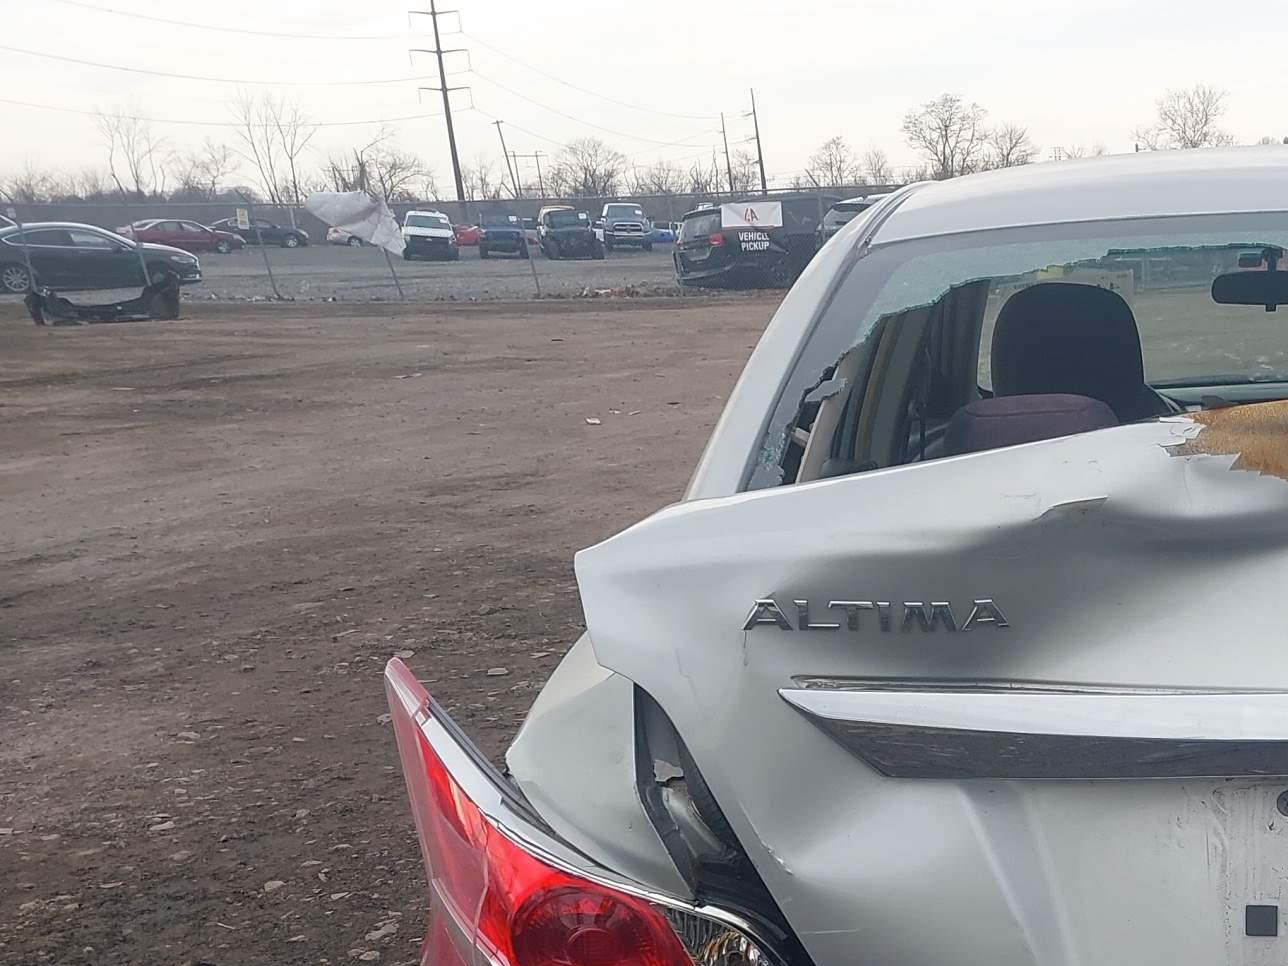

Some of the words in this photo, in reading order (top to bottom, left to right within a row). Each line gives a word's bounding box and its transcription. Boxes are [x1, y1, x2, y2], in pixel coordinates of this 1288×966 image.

[739, 232, 769, 241] VEHICLE
[741, 242, 769, 251] PICKUP
[741, 599, 1010, 632] ALTIMA
